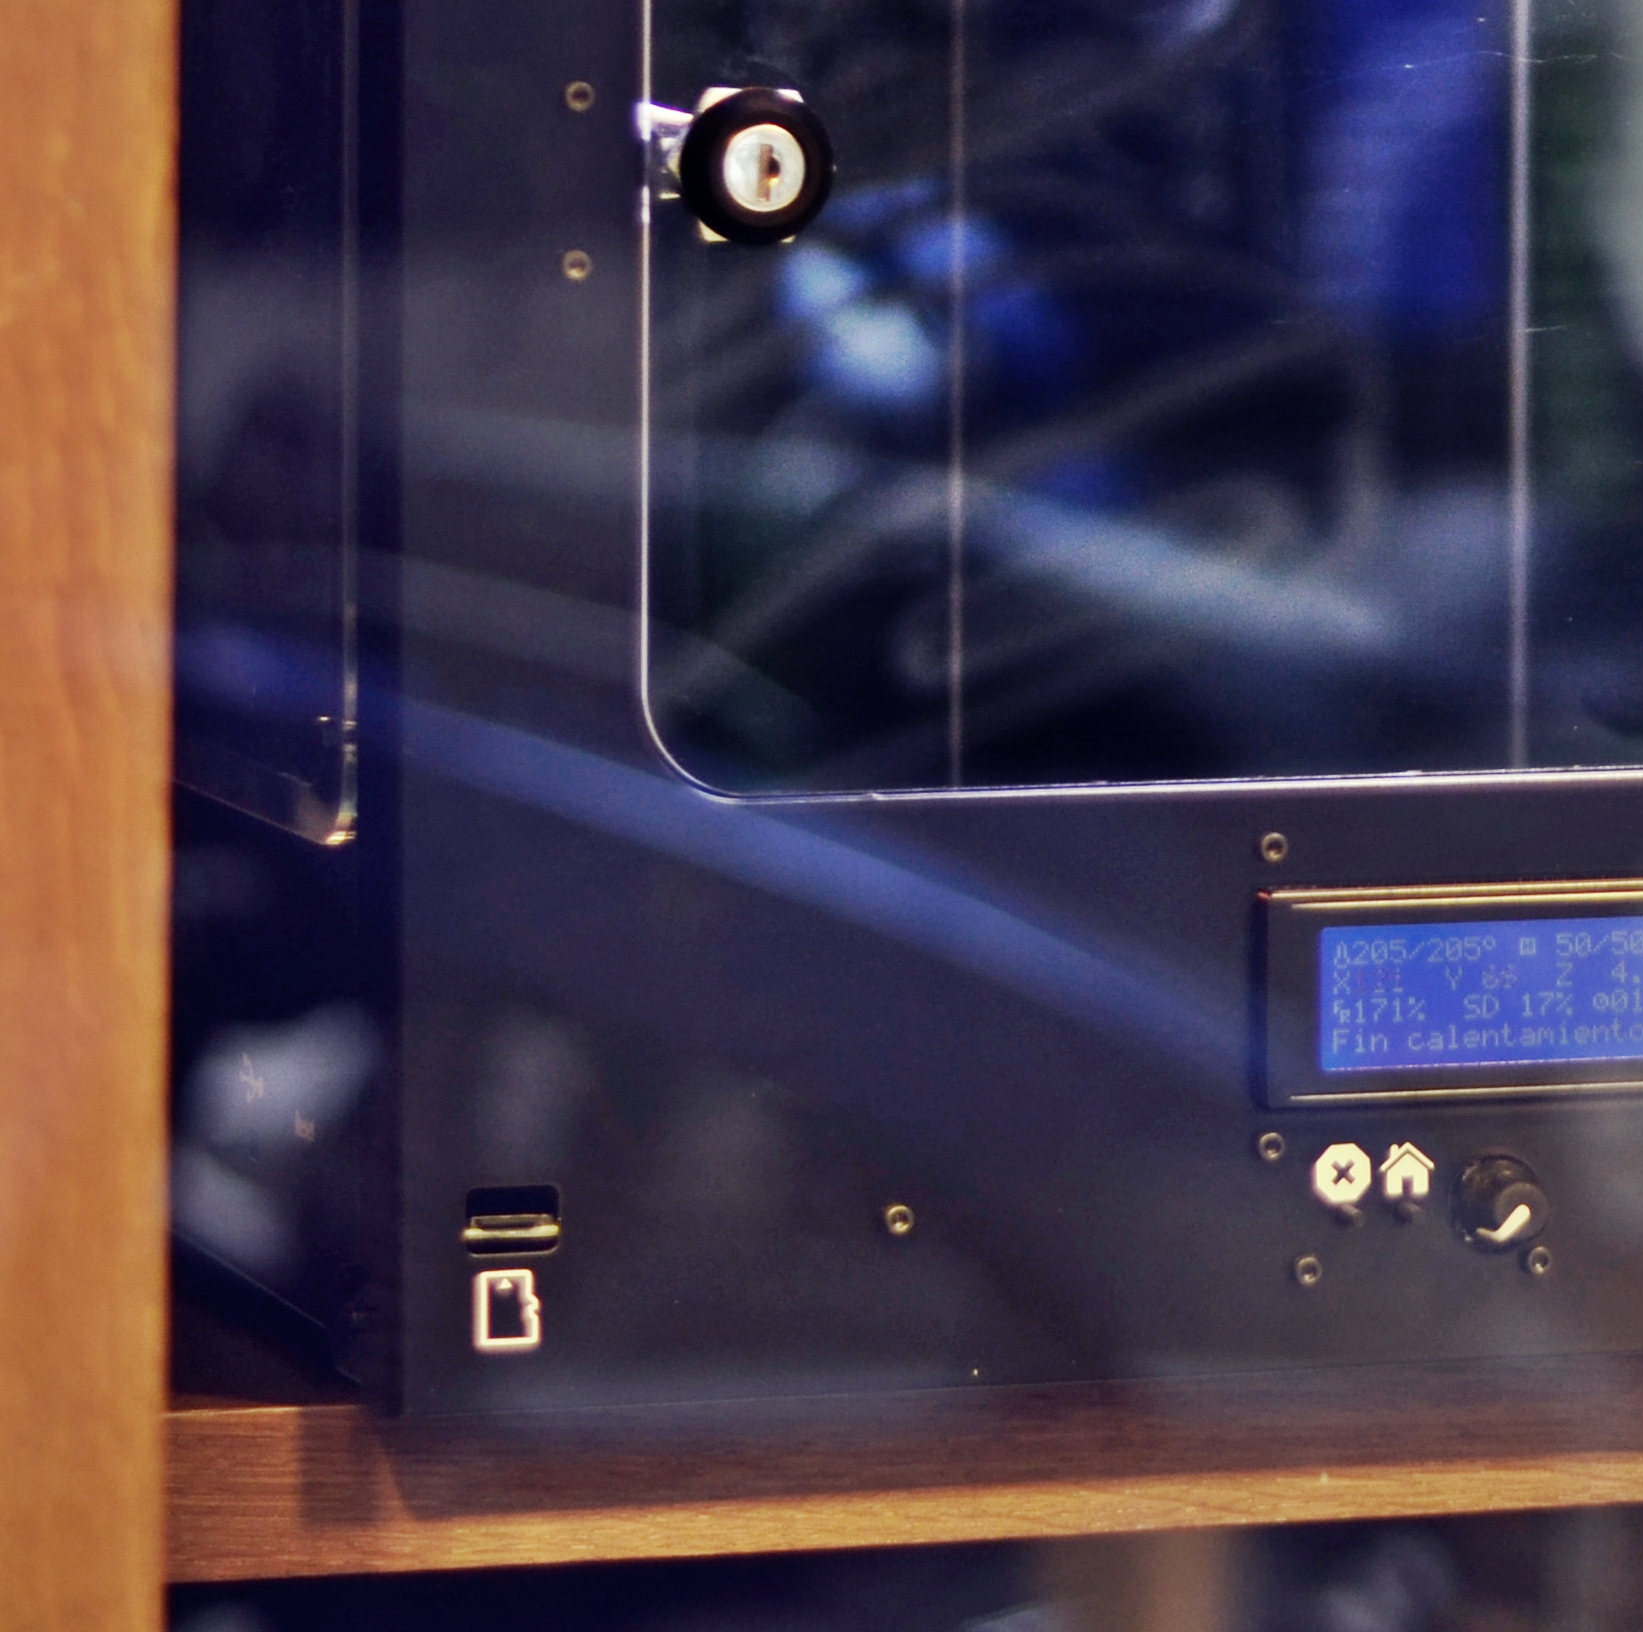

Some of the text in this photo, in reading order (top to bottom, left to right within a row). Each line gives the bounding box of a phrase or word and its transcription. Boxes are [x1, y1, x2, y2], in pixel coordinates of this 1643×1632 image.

[1463, 993, 1501, 1020] SD
[1520, 991, 1574, 1017] 17%
[1331, 1027, 1389, 1054] Fin
